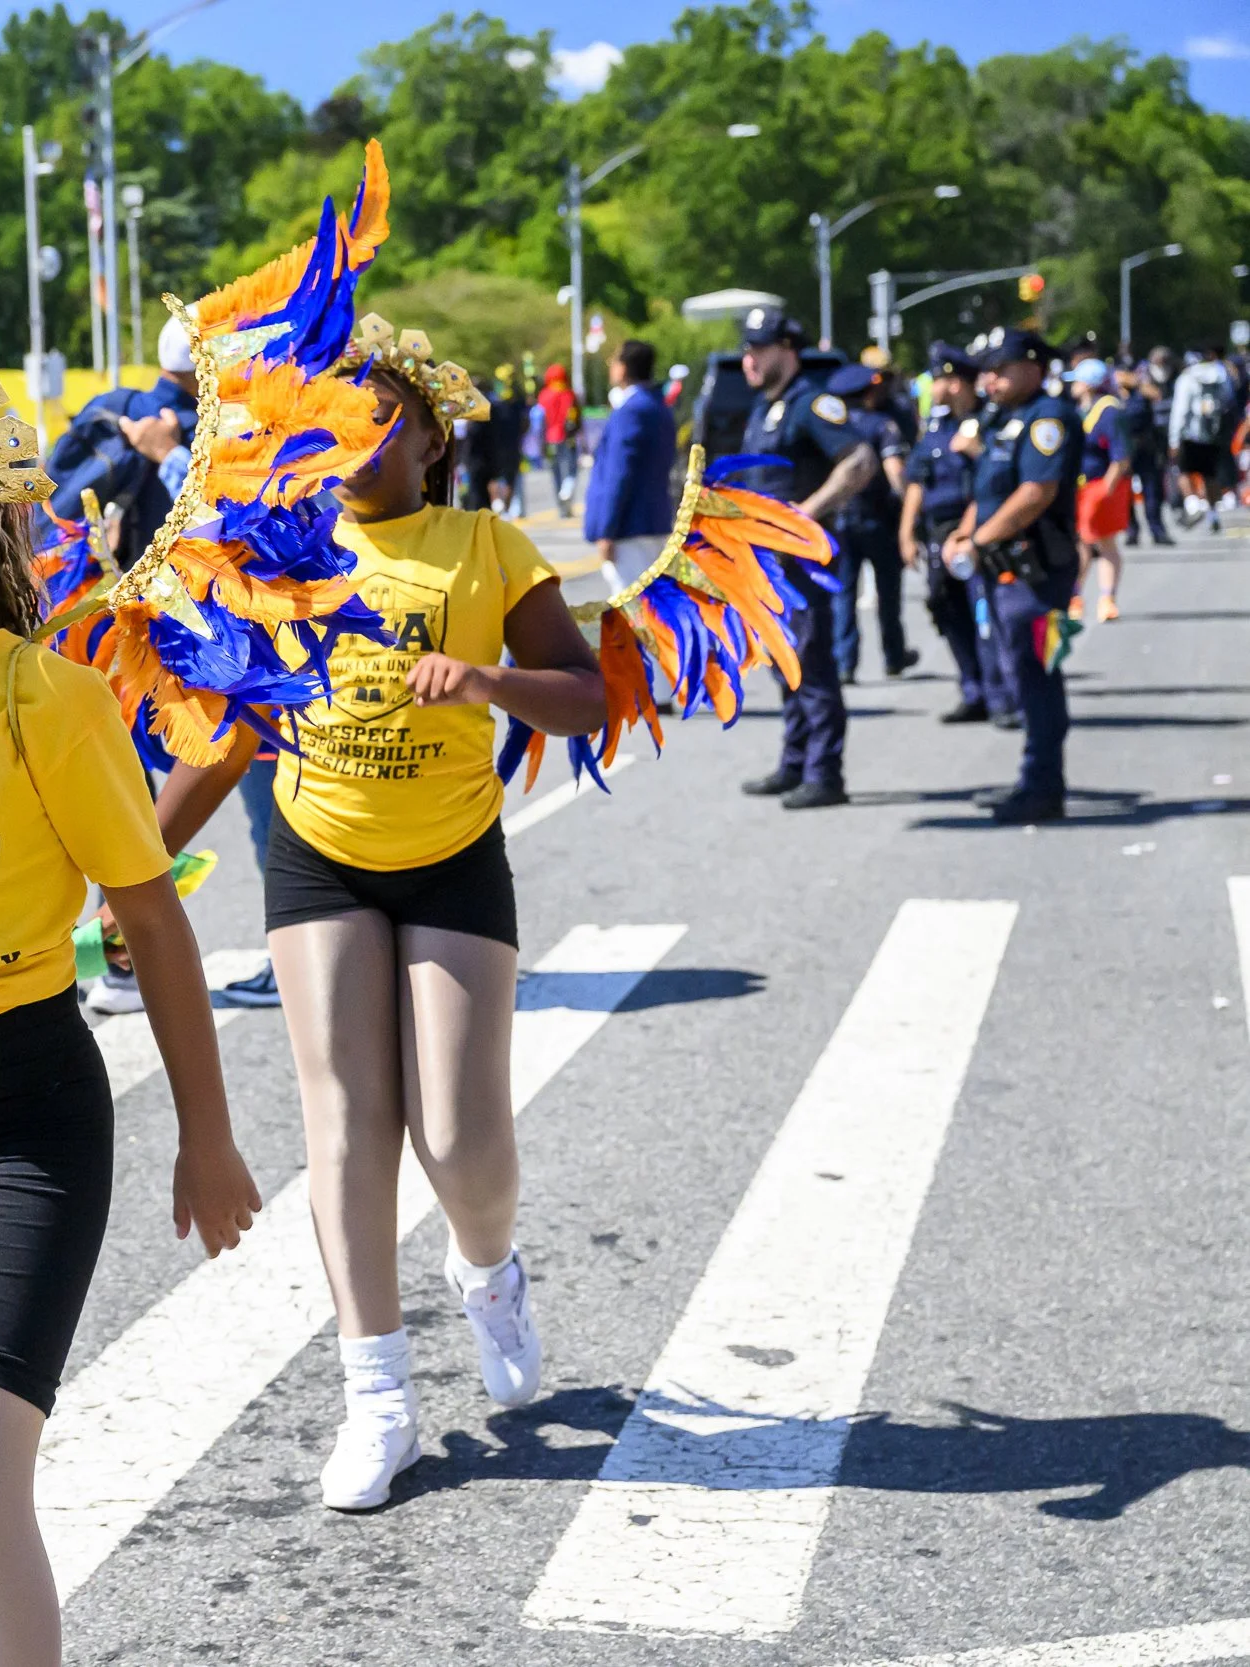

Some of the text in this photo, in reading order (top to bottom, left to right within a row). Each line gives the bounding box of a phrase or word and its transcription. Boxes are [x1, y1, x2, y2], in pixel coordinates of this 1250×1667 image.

[353, 675, 400, 684] ADEM
[318, 724, 414, 743] RESPECT.
[299, 731, 448, 762] ESPONSIBILITY.
